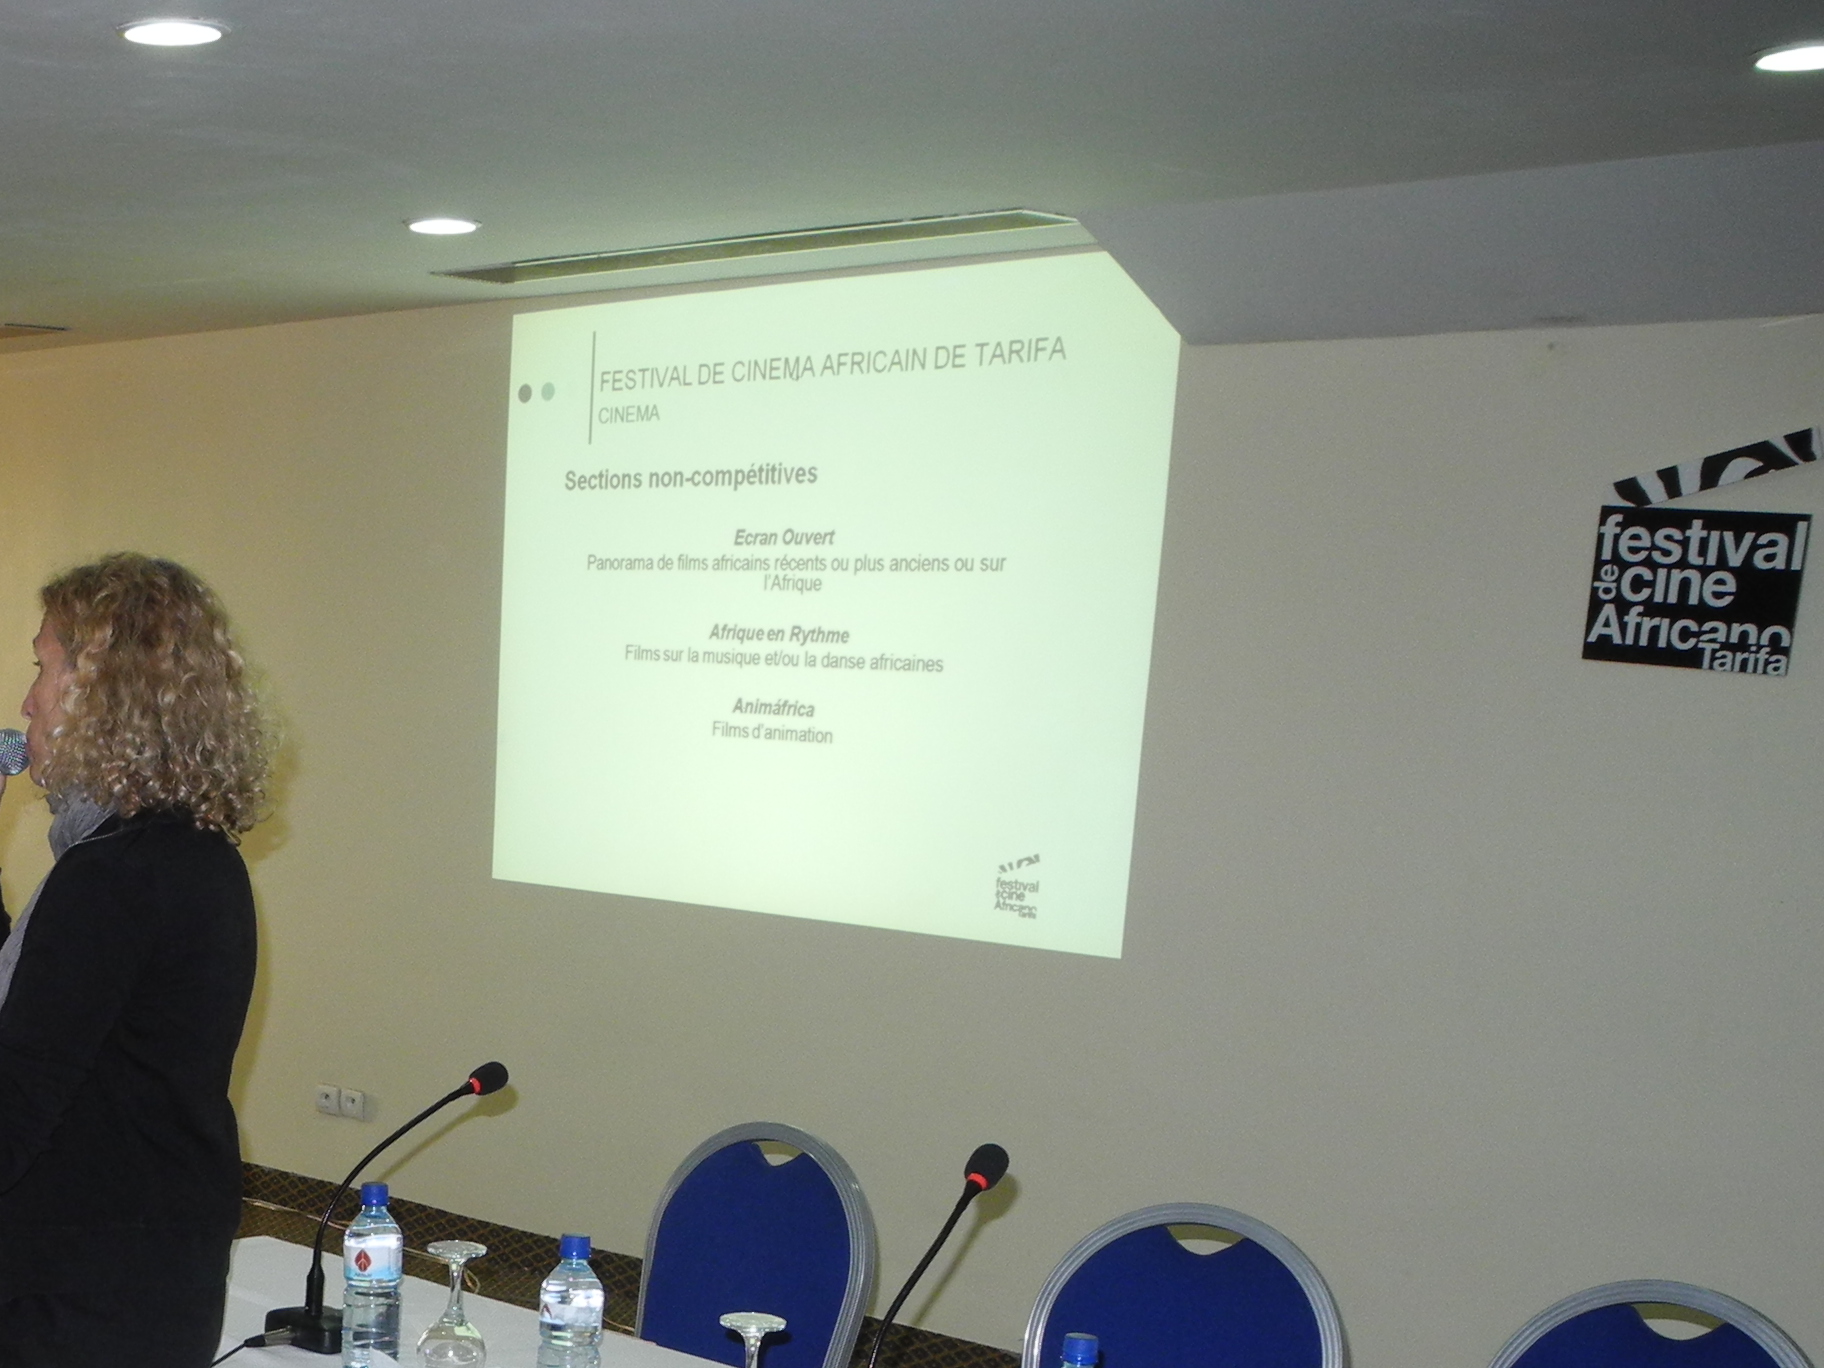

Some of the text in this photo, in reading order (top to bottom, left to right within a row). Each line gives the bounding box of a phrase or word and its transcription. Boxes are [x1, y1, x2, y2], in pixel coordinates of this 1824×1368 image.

[599, 335, 1067, 392] FESTIVAL DE CINEMA AFRICAIN DE TARIFA
[598, 403, 661, 425] CINEMA
[564, 461, 819, 491] Sections non-compétitives
[733, 527, 836, 547] Ecran Ouvert
[1598, 512, 1809, 571] festival
[587, 553, 1007, 576] Panorama de films africains récents ou plus anciens ou sur
[763, 573, 823, 595] l'Afrique
[1620, 565, 1738, 608] cine
[708, 622, 850, 647] Afrique en Rythme
[1586, 602, 1792, 651] Africano
[624, 644, 944, 673] Films sur la musique et/ou la danse africaines
[1697, 641, 1789, 677] Tarifa
[732, 697, 816, 719] Animáfrica
[712, 720, 834, 745] Films d'animation
